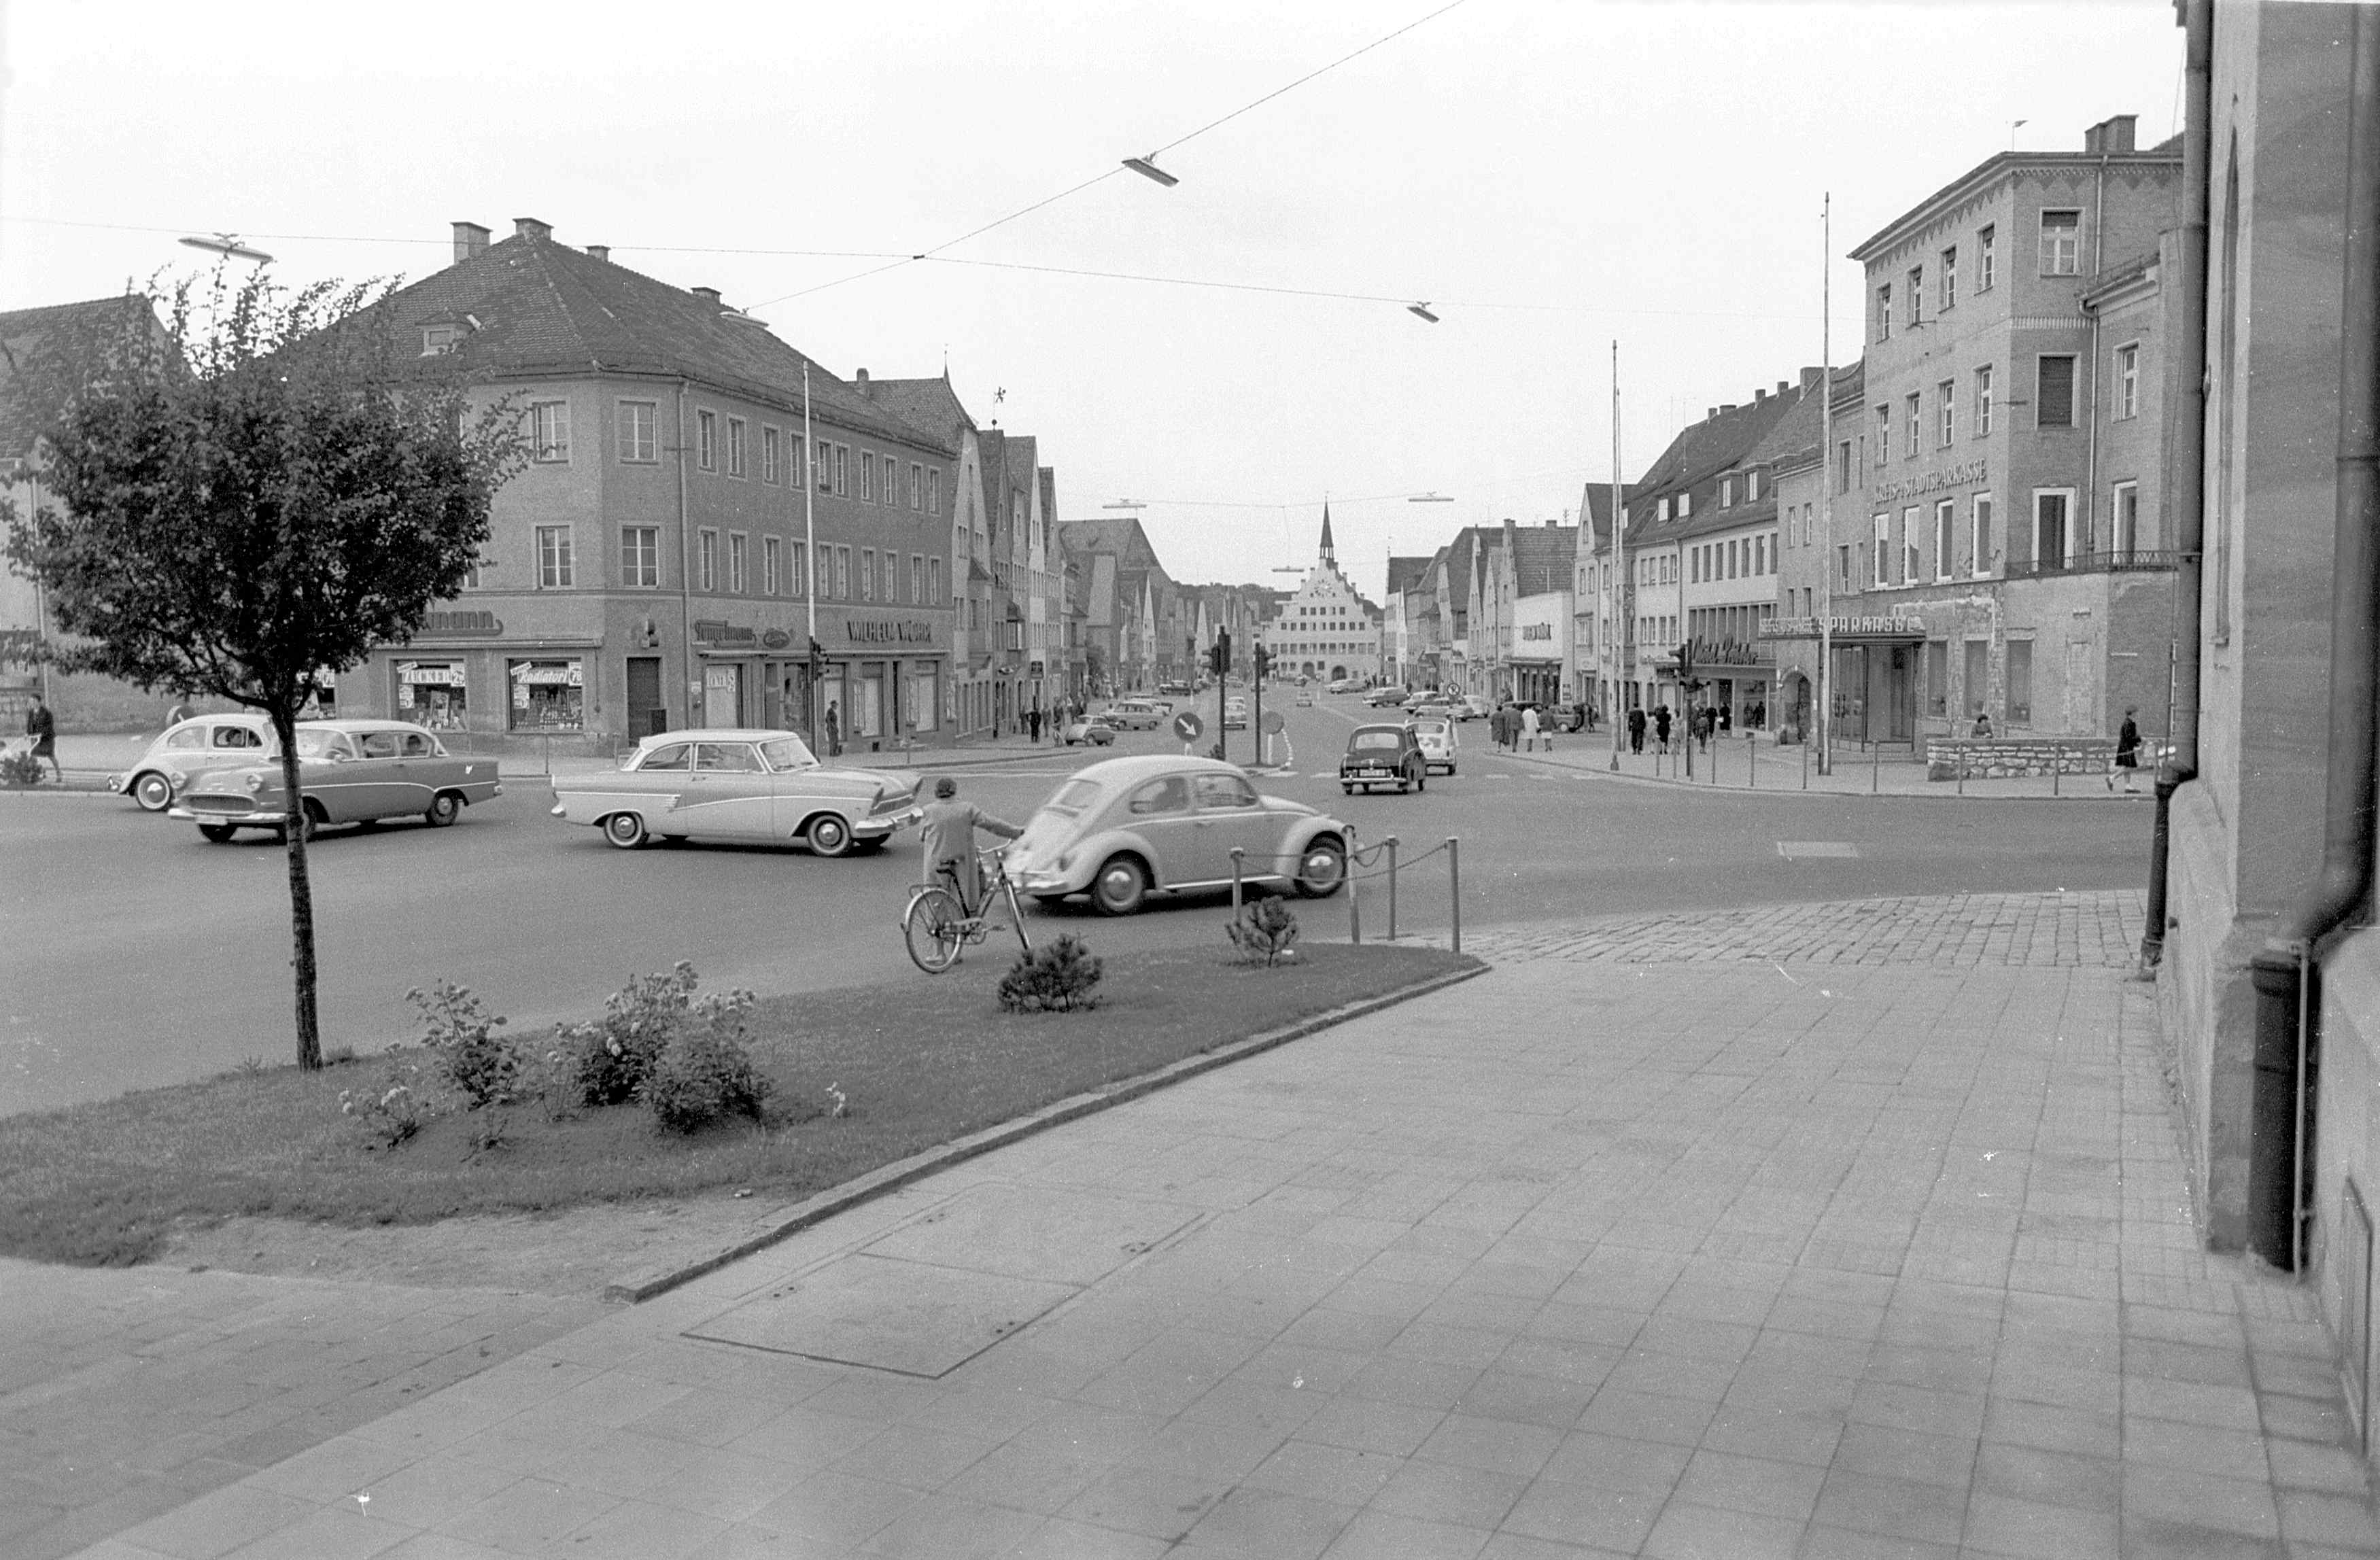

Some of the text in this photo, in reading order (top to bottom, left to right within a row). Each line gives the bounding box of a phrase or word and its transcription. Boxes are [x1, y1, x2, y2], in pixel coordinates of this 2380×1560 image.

[1904, 457, 1987, 498] STADTSPARKASSE
[847, 619, 896, 642] WILHELM
[1818, 615, 1916, 634] SPARKASSE
[403, 670, 450, 684] ZUCKER
